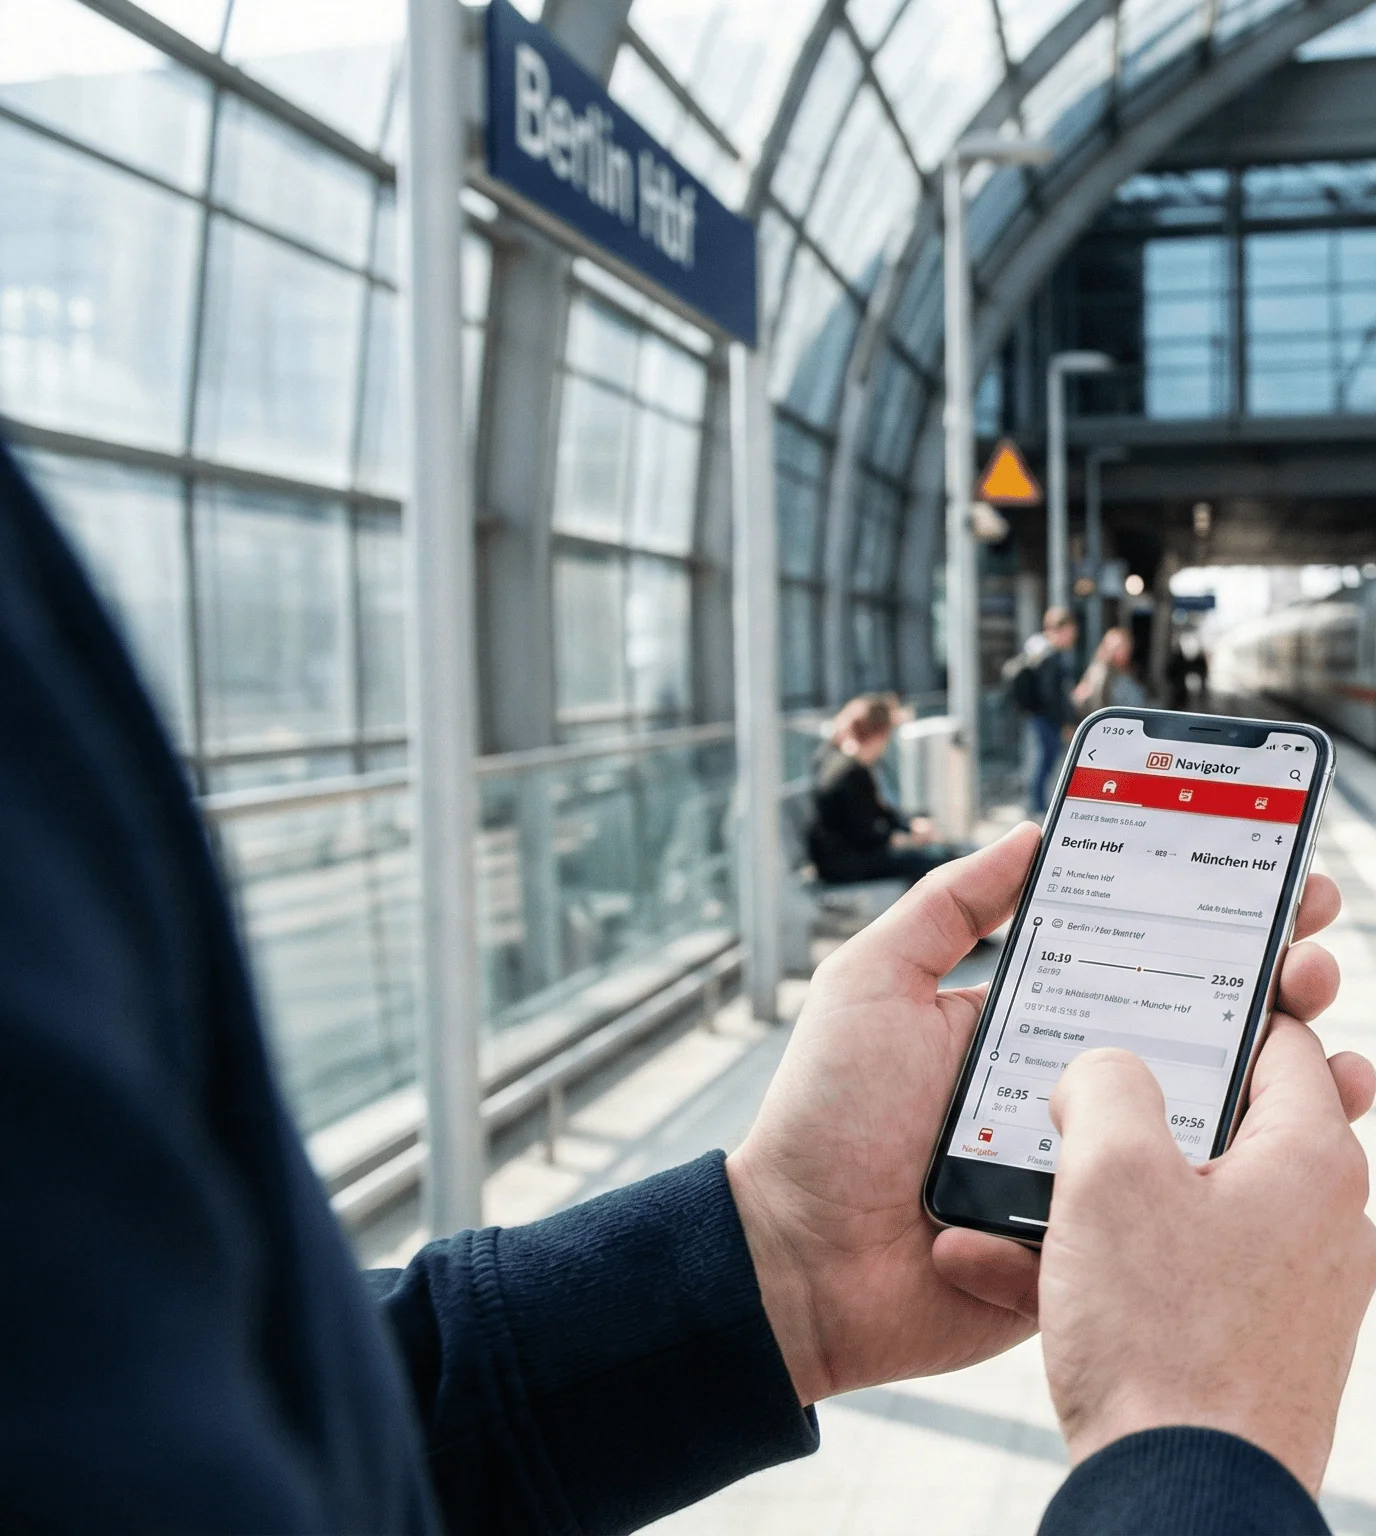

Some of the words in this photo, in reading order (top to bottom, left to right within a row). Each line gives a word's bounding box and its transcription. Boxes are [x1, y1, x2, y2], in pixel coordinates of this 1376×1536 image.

[514, 42, 634, 226] Berlin
[638, 150, 697, 269] Hbf
[1148, 753, 1170, 769] DB
[1175, 758, 1241, 776] Navigator
[1099, 840, 1125, 854] Hbf
[1190, 851, 1249, 869] München
[1251, 858, 1277, 872] Hbf
[1210, 974, 1244, 988] 23.09
[1173, 1003, 1192, 1014] Hbf
